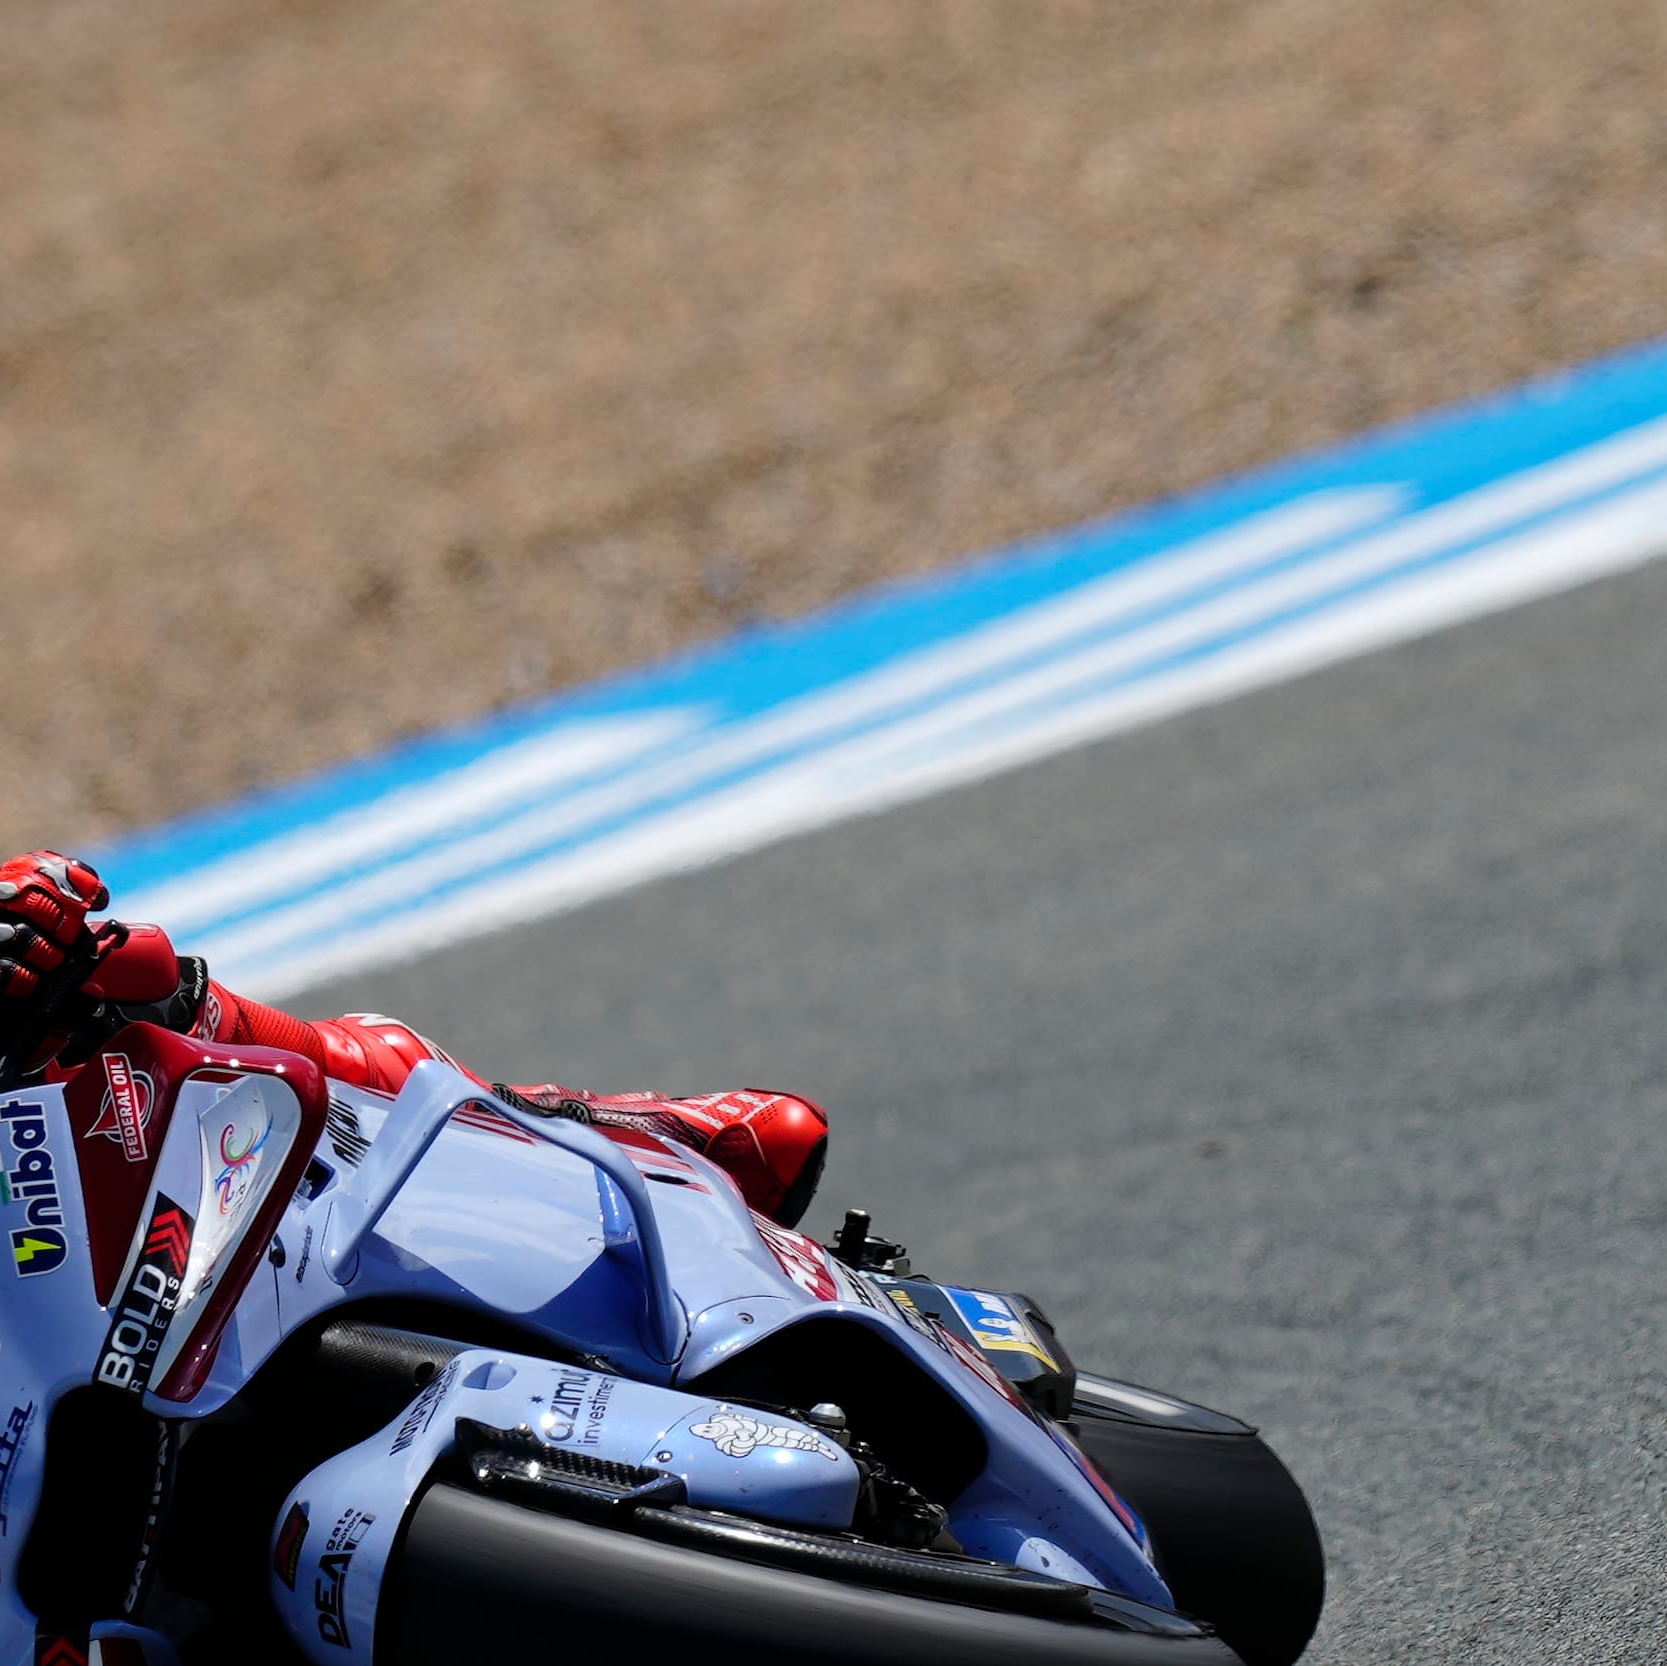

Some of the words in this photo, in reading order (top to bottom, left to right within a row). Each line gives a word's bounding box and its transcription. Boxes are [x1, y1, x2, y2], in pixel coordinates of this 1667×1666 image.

[112, 1060, 128, 1086] OIL
[117, 1085, 142, 1157] FEDERAL
[98, 1263, 166, 1391] BOLD
[130, 1276, 181, 1393] RIDERS
[325, 1507, 354, 1552] gate
[334, 1511, 363, 1552] motors
[315, 1550, 354, 1650] DEA
